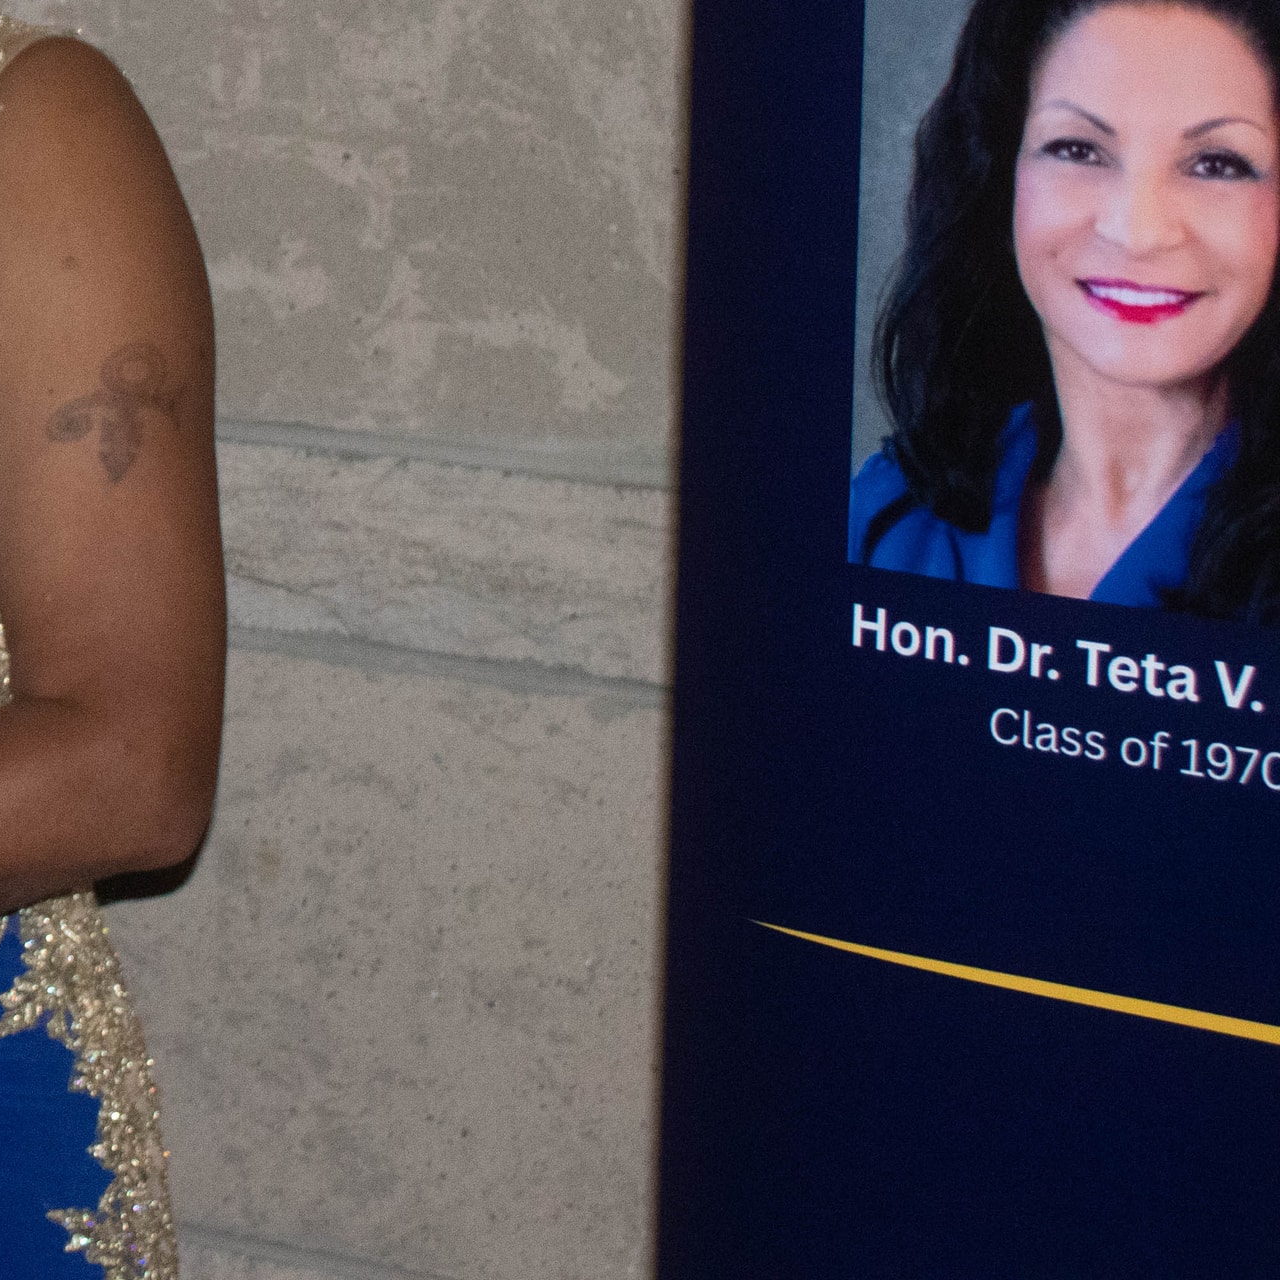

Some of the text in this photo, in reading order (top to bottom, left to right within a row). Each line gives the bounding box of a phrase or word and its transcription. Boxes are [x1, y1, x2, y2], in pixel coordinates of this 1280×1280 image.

[852, 603, 1265, 712] Hon. Dr. Teta V.
[989, 707, 1280, 791] Class of 1970
